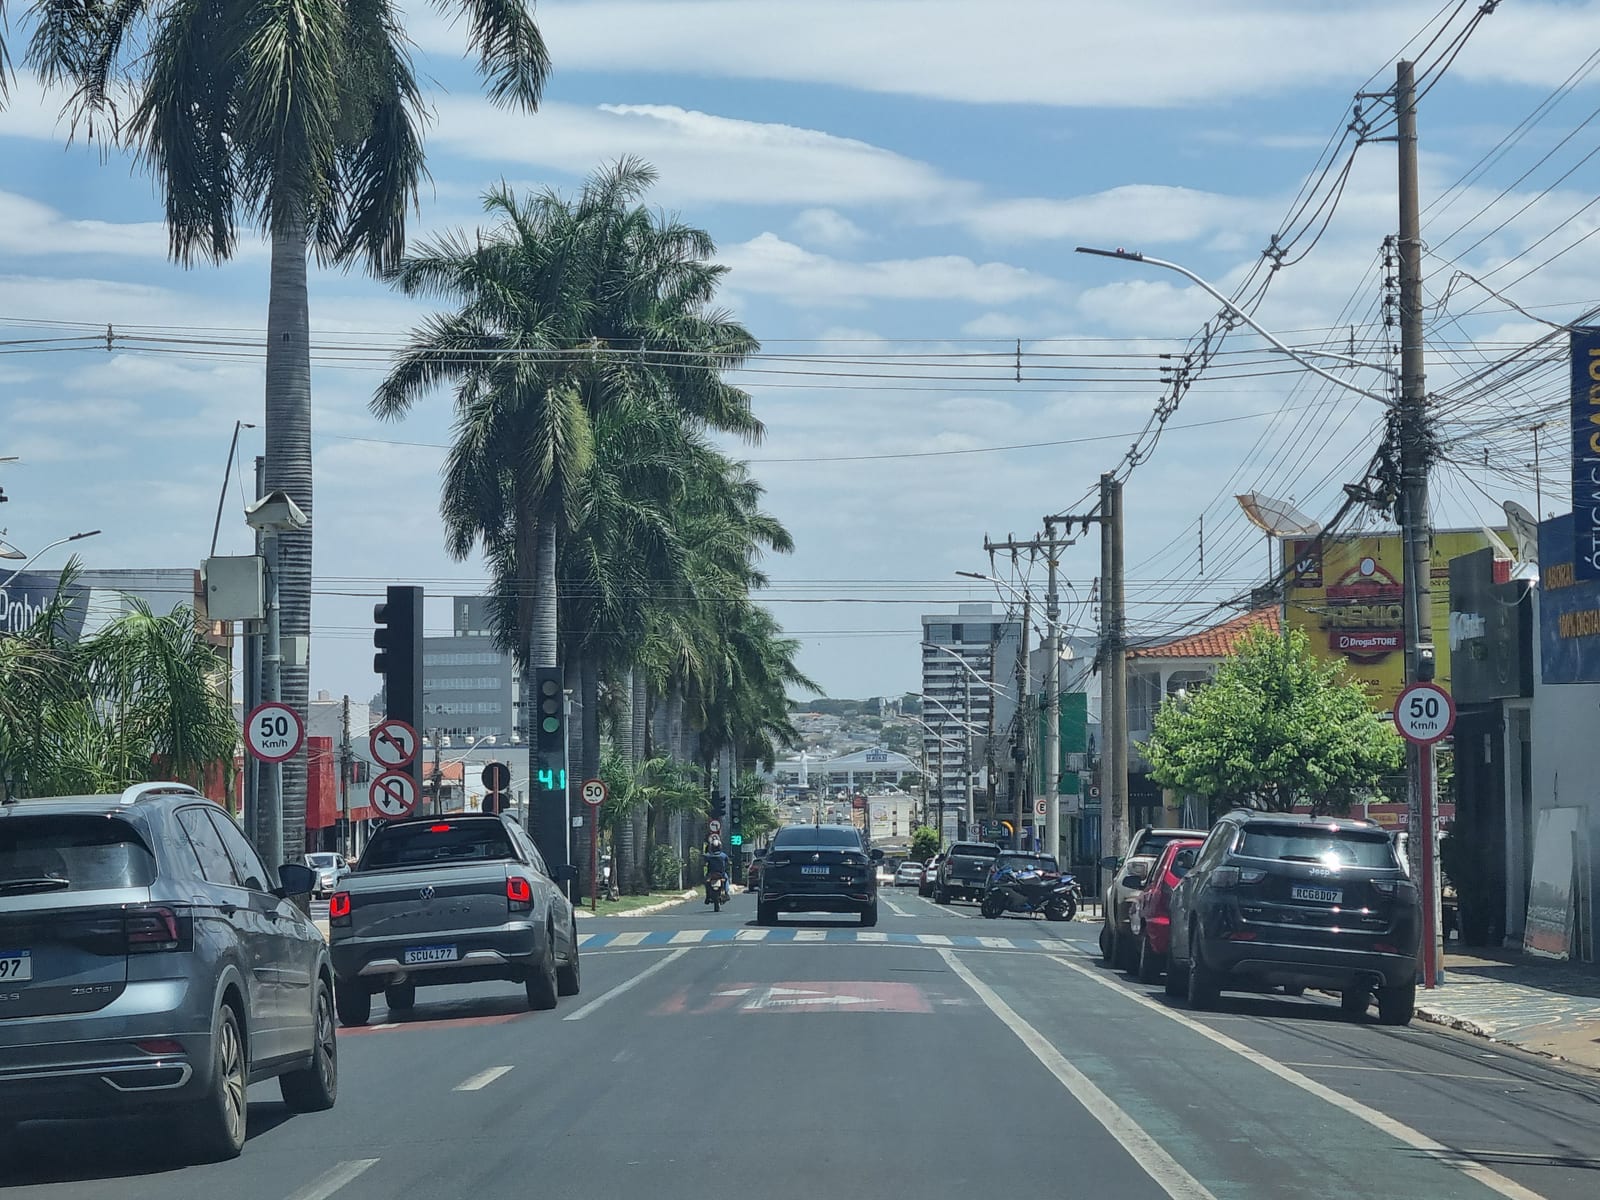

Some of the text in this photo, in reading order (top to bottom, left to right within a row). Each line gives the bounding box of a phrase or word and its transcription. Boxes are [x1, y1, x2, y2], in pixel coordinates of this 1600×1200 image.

[1349, 637, 1397, 648] DrogaSTORE
[1410, 697, 1439, 718] 50
[261, 716, 288, 737] 50
[1410, 720, 1438, 730] Km/h
[262, 739, 288, 748] Km/h
[538, 769, 565, 790] 41
[586, 786, 602, 797] 50
[1039, 803, 1045, 812] E
[410, 949, 452, 962] SCU4177
